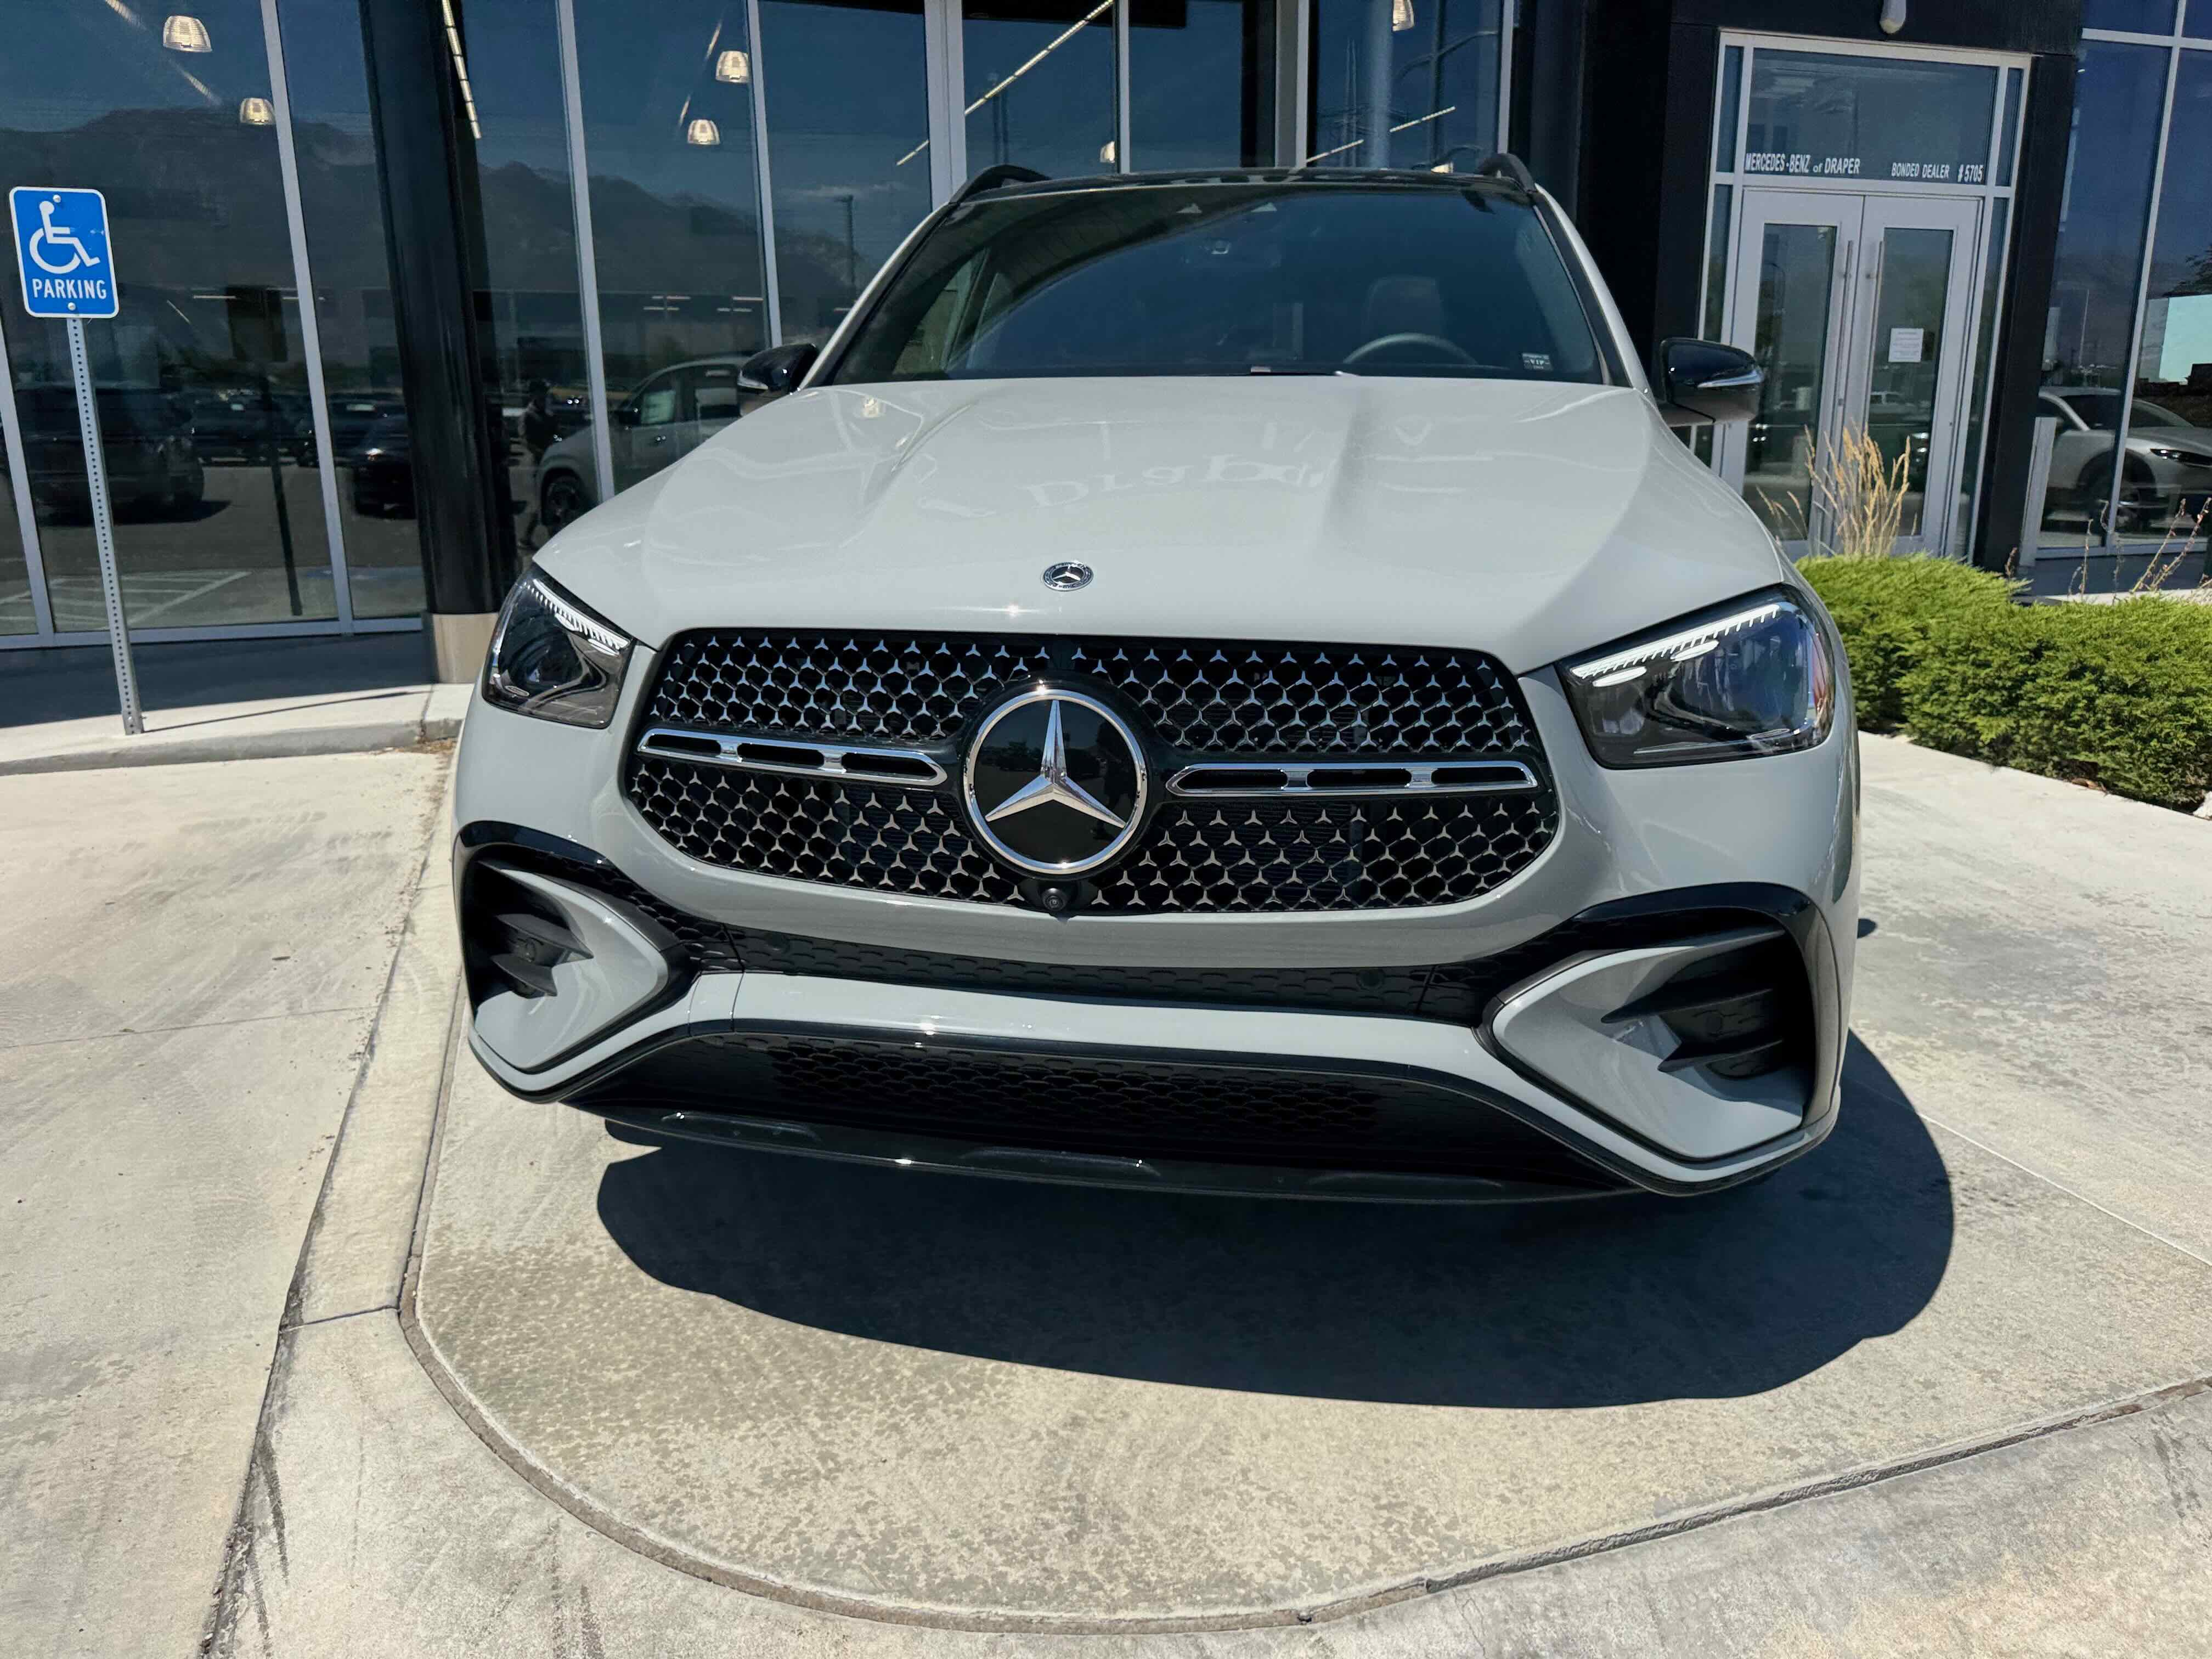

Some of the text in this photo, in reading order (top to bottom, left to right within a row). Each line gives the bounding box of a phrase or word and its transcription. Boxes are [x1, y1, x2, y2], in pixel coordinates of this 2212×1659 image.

[1813, 163, 1823, 173] of
[1824, 157, 1861, 174] DRAPER
[1891, 162, 1920, 177] BONDED
[1922, 163, 1950, 179] DEALER
[32, 278, 107, 300] PARKING
